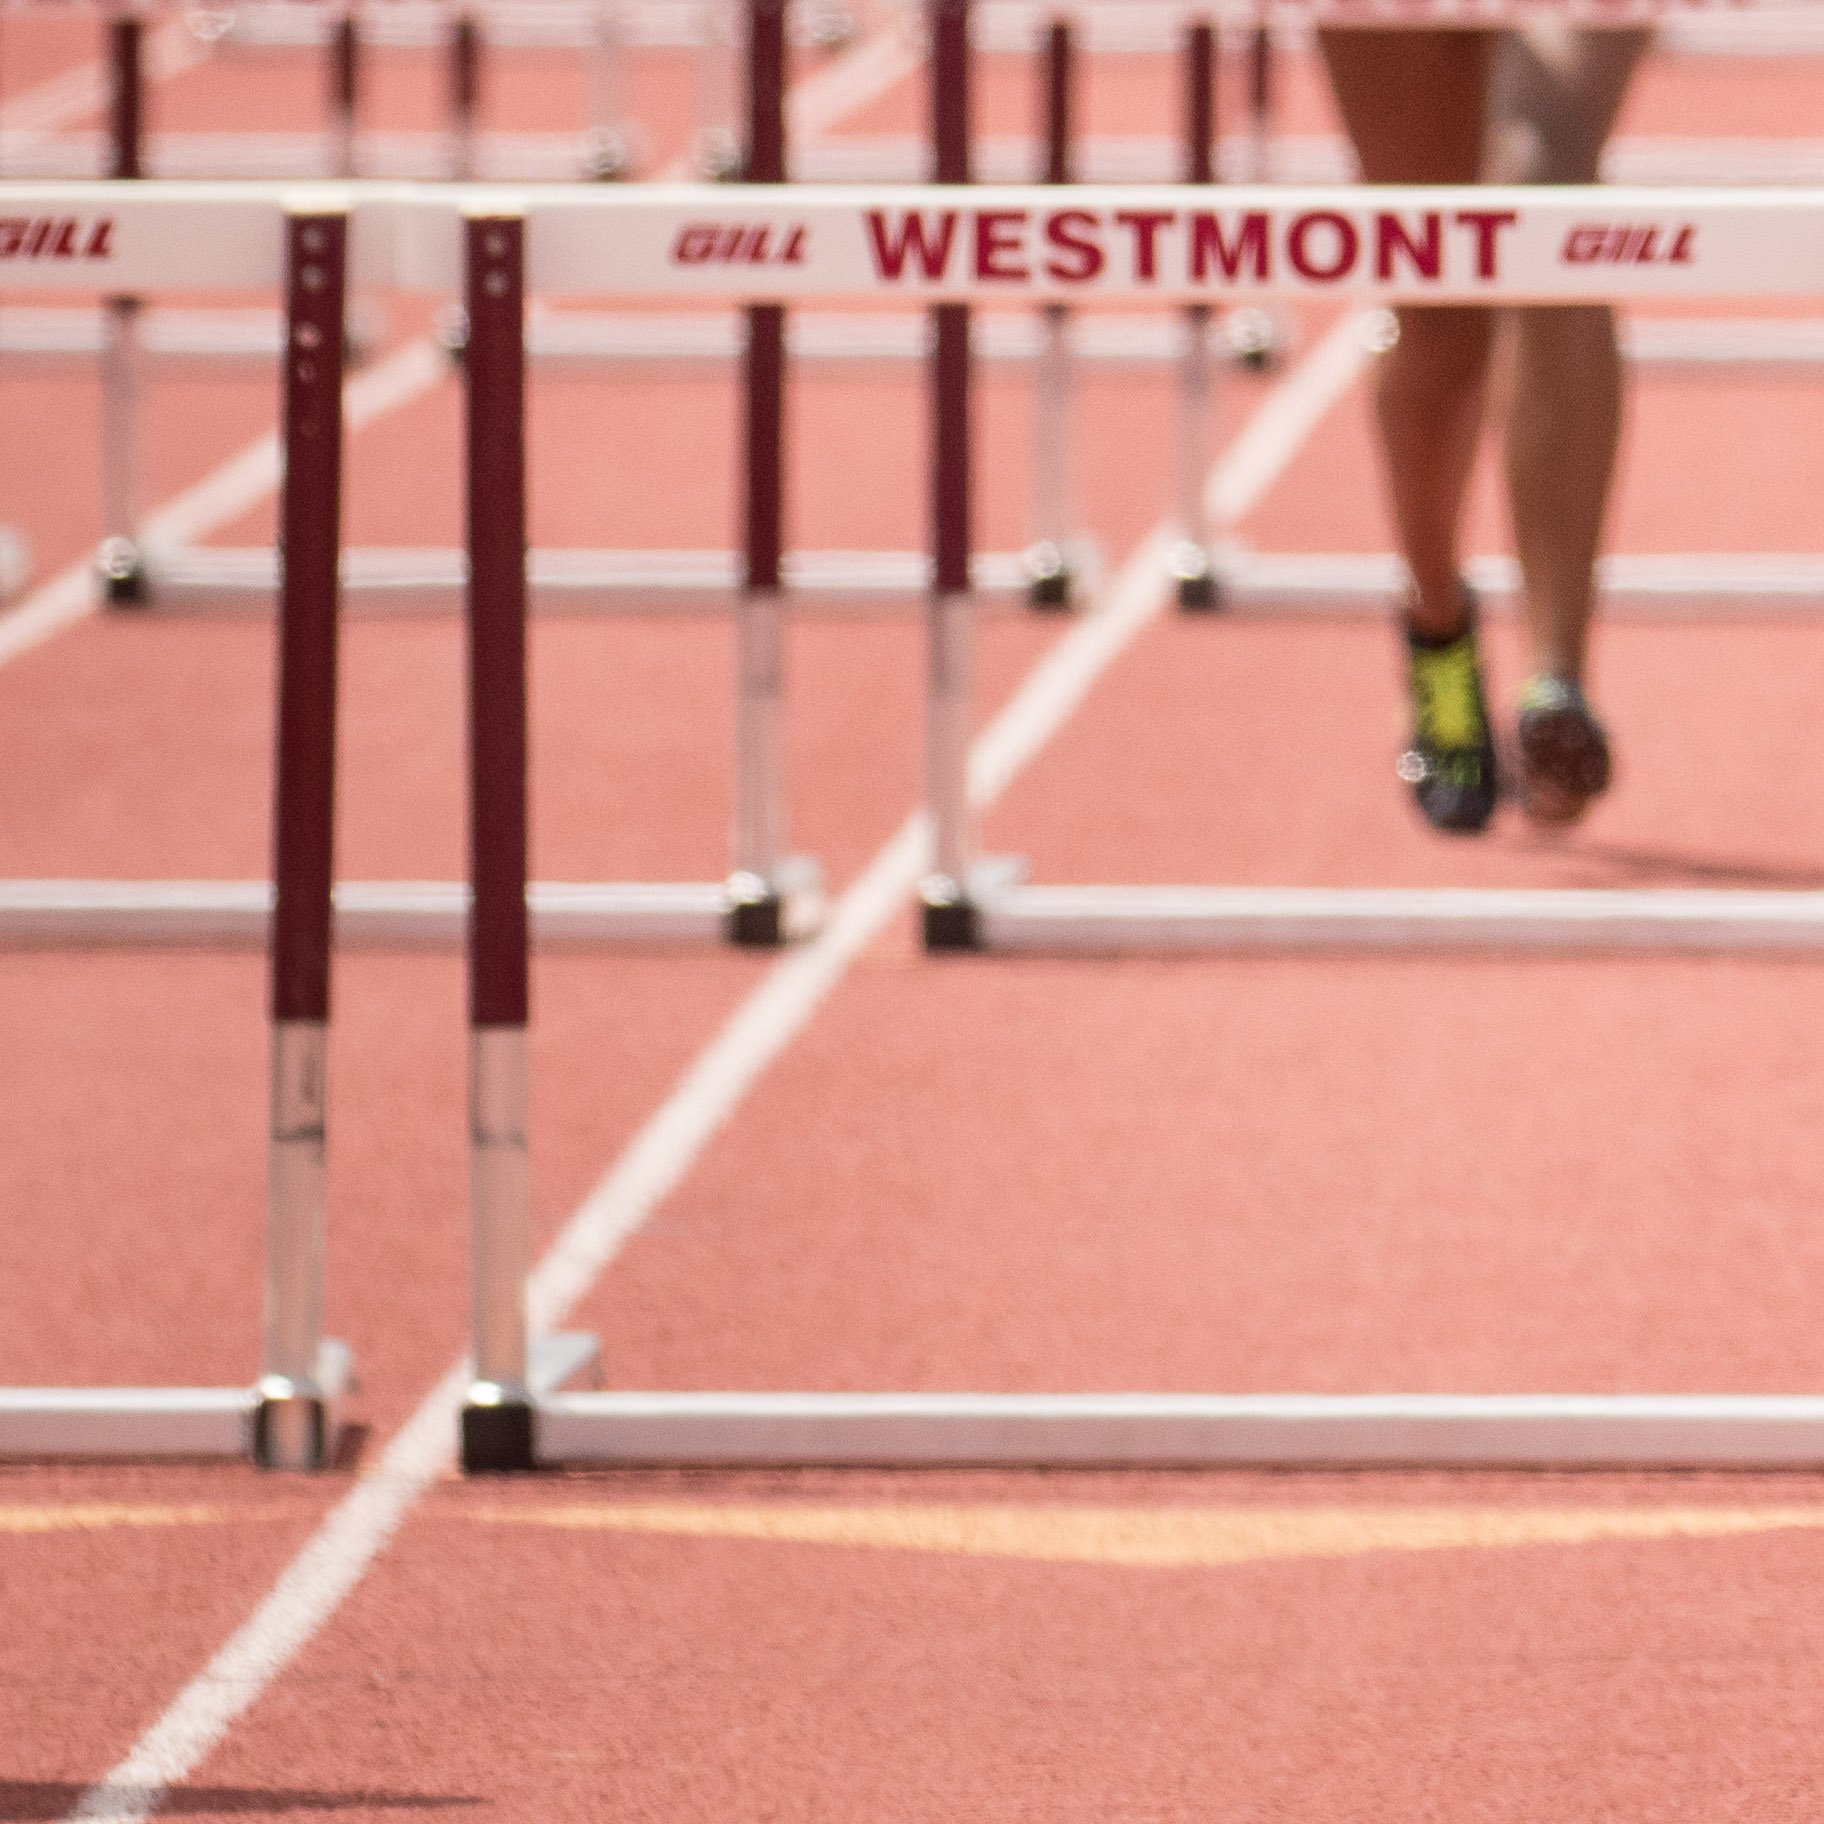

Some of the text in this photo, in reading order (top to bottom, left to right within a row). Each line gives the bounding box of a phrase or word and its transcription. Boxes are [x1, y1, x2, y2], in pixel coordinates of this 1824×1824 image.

[669, 210, 1698, 284] GILL WESTMONT GILL
